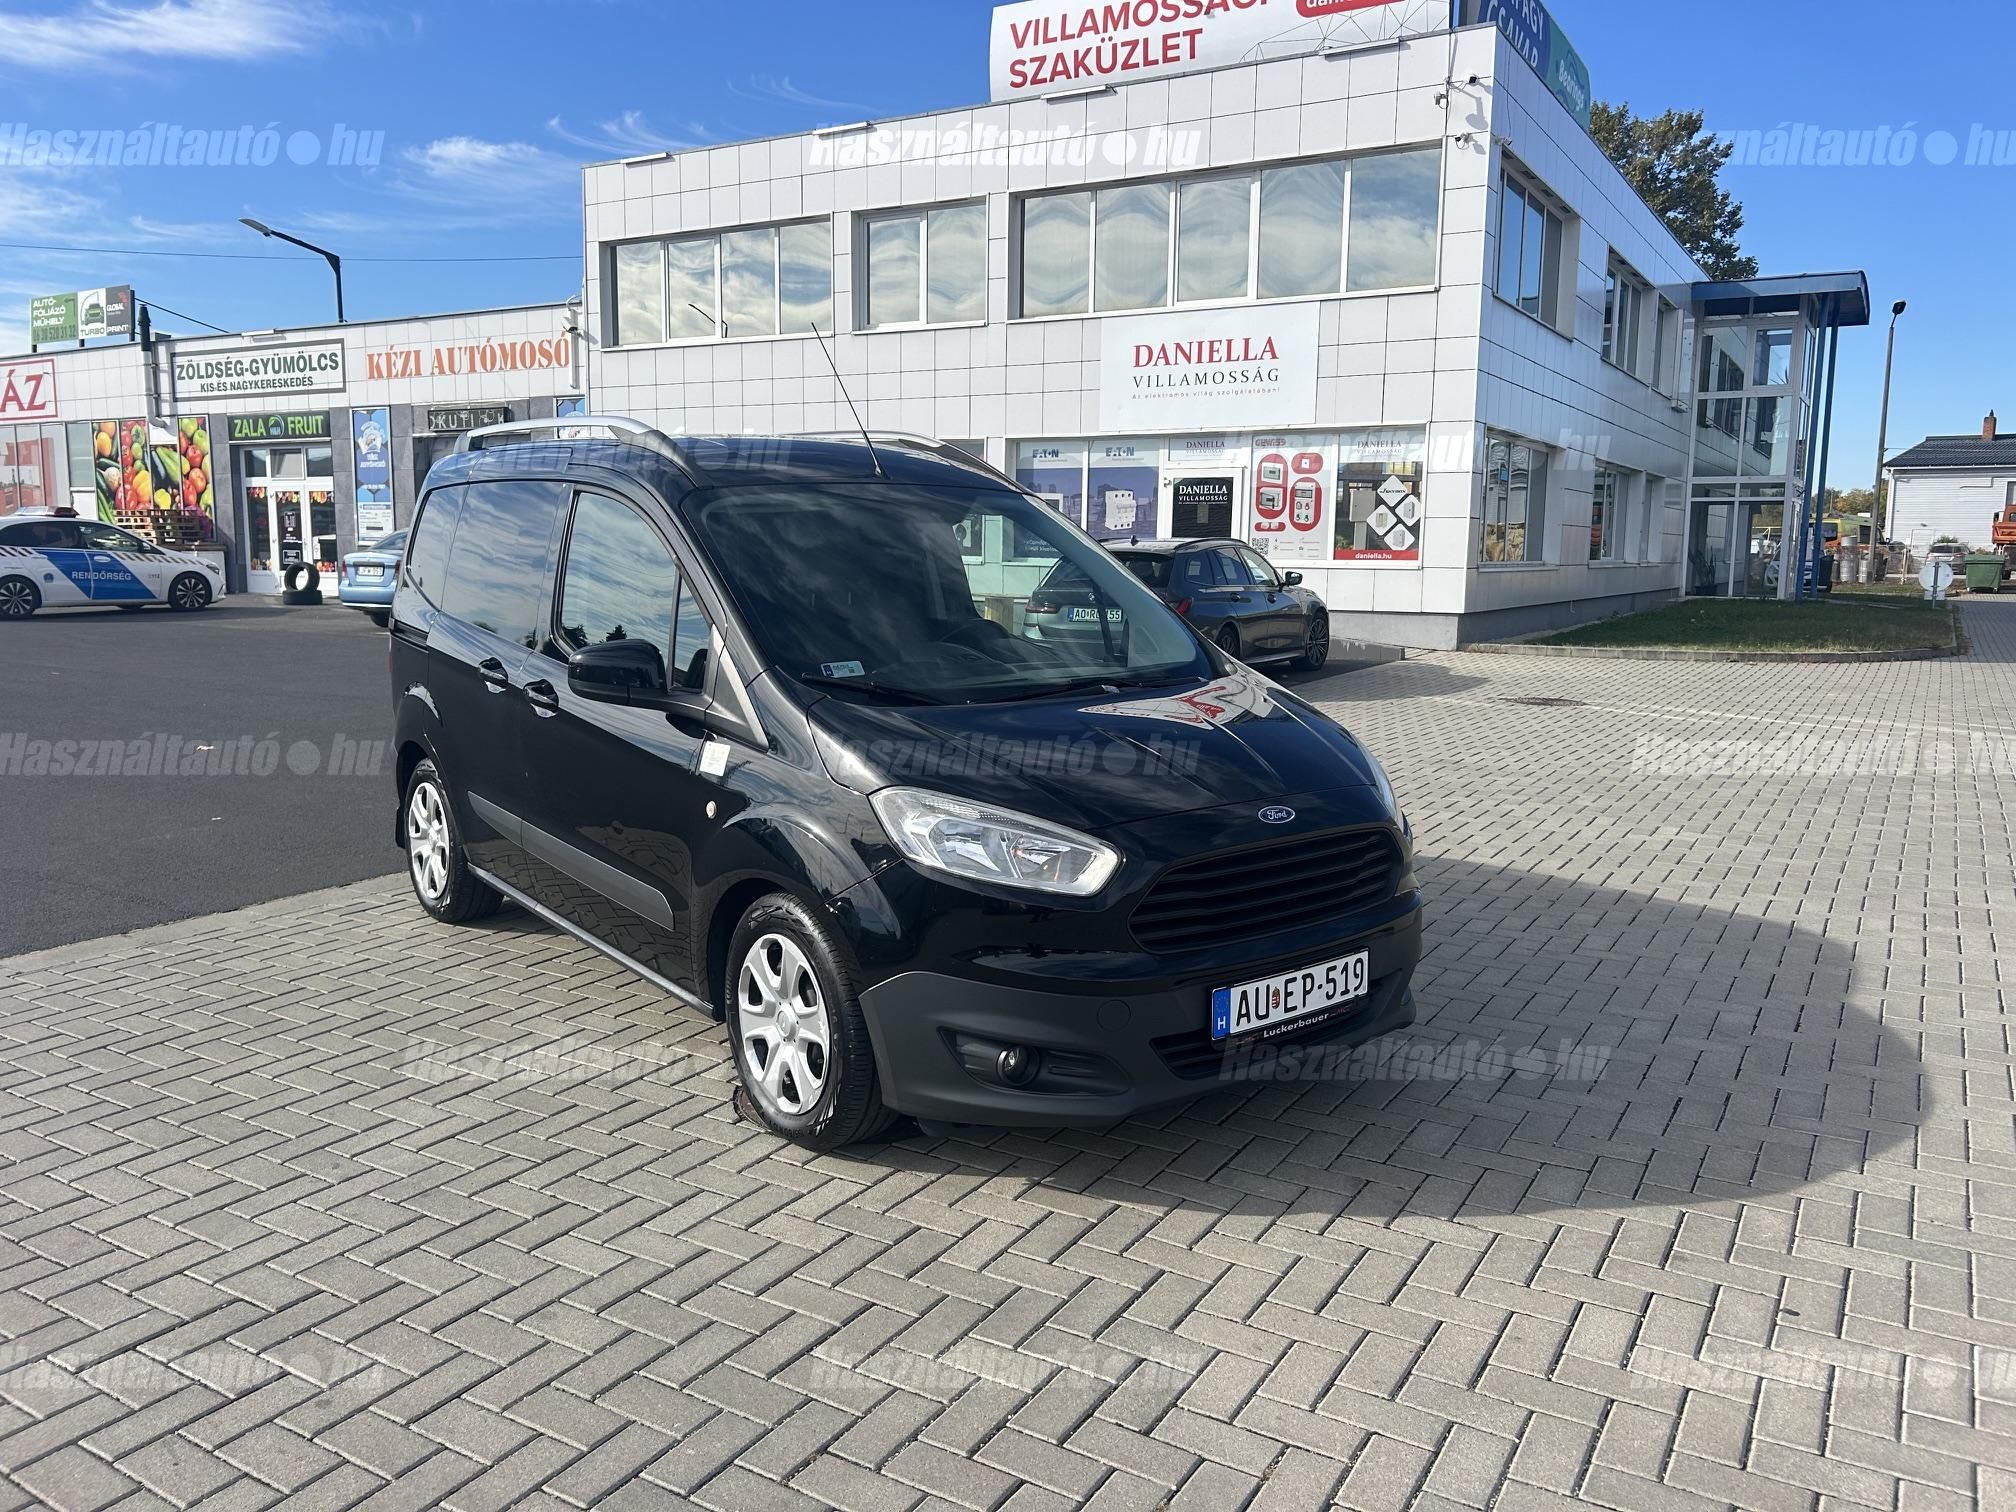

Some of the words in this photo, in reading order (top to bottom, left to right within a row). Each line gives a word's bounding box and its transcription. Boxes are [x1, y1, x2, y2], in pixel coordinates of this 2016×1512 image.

[1010, 0, 1268, 50] VILLAMOSS
[1009, 27, 1203, 89] SZAKÜZLET
[80, 327, 105, 336] TURBO
[106, 324, 128, 333] PRINT
[367, 345, 422, 380] KÉZI
[430, 331, 569, 376] AUTÓMOSÓ
[1133, 336, 1279, 367] DANIELLA
[176, 351, 339, 380] ZÖLDSÉG-GYÜMÖLCS
[230, 374, 314, 391] NAGYKERESKEDÉS
[1133, 366, 1279, 388] VILLAMOSSÁG
[234, 418, 266, 437] ZALA
[287, 415, 324, 436] FRUIT
[1186, 440, 1225, 448] DANIELLA
[1179, 485, 1228, 494] DANIELLA
[1355, 552, 1392, 560] daniella.hu
[71, 570, 132, 581] RENDŐRSÉG
[1266, 809, 1287, 820] Ford
[1263, 1012, 1329, 1038] Luckerbauer
